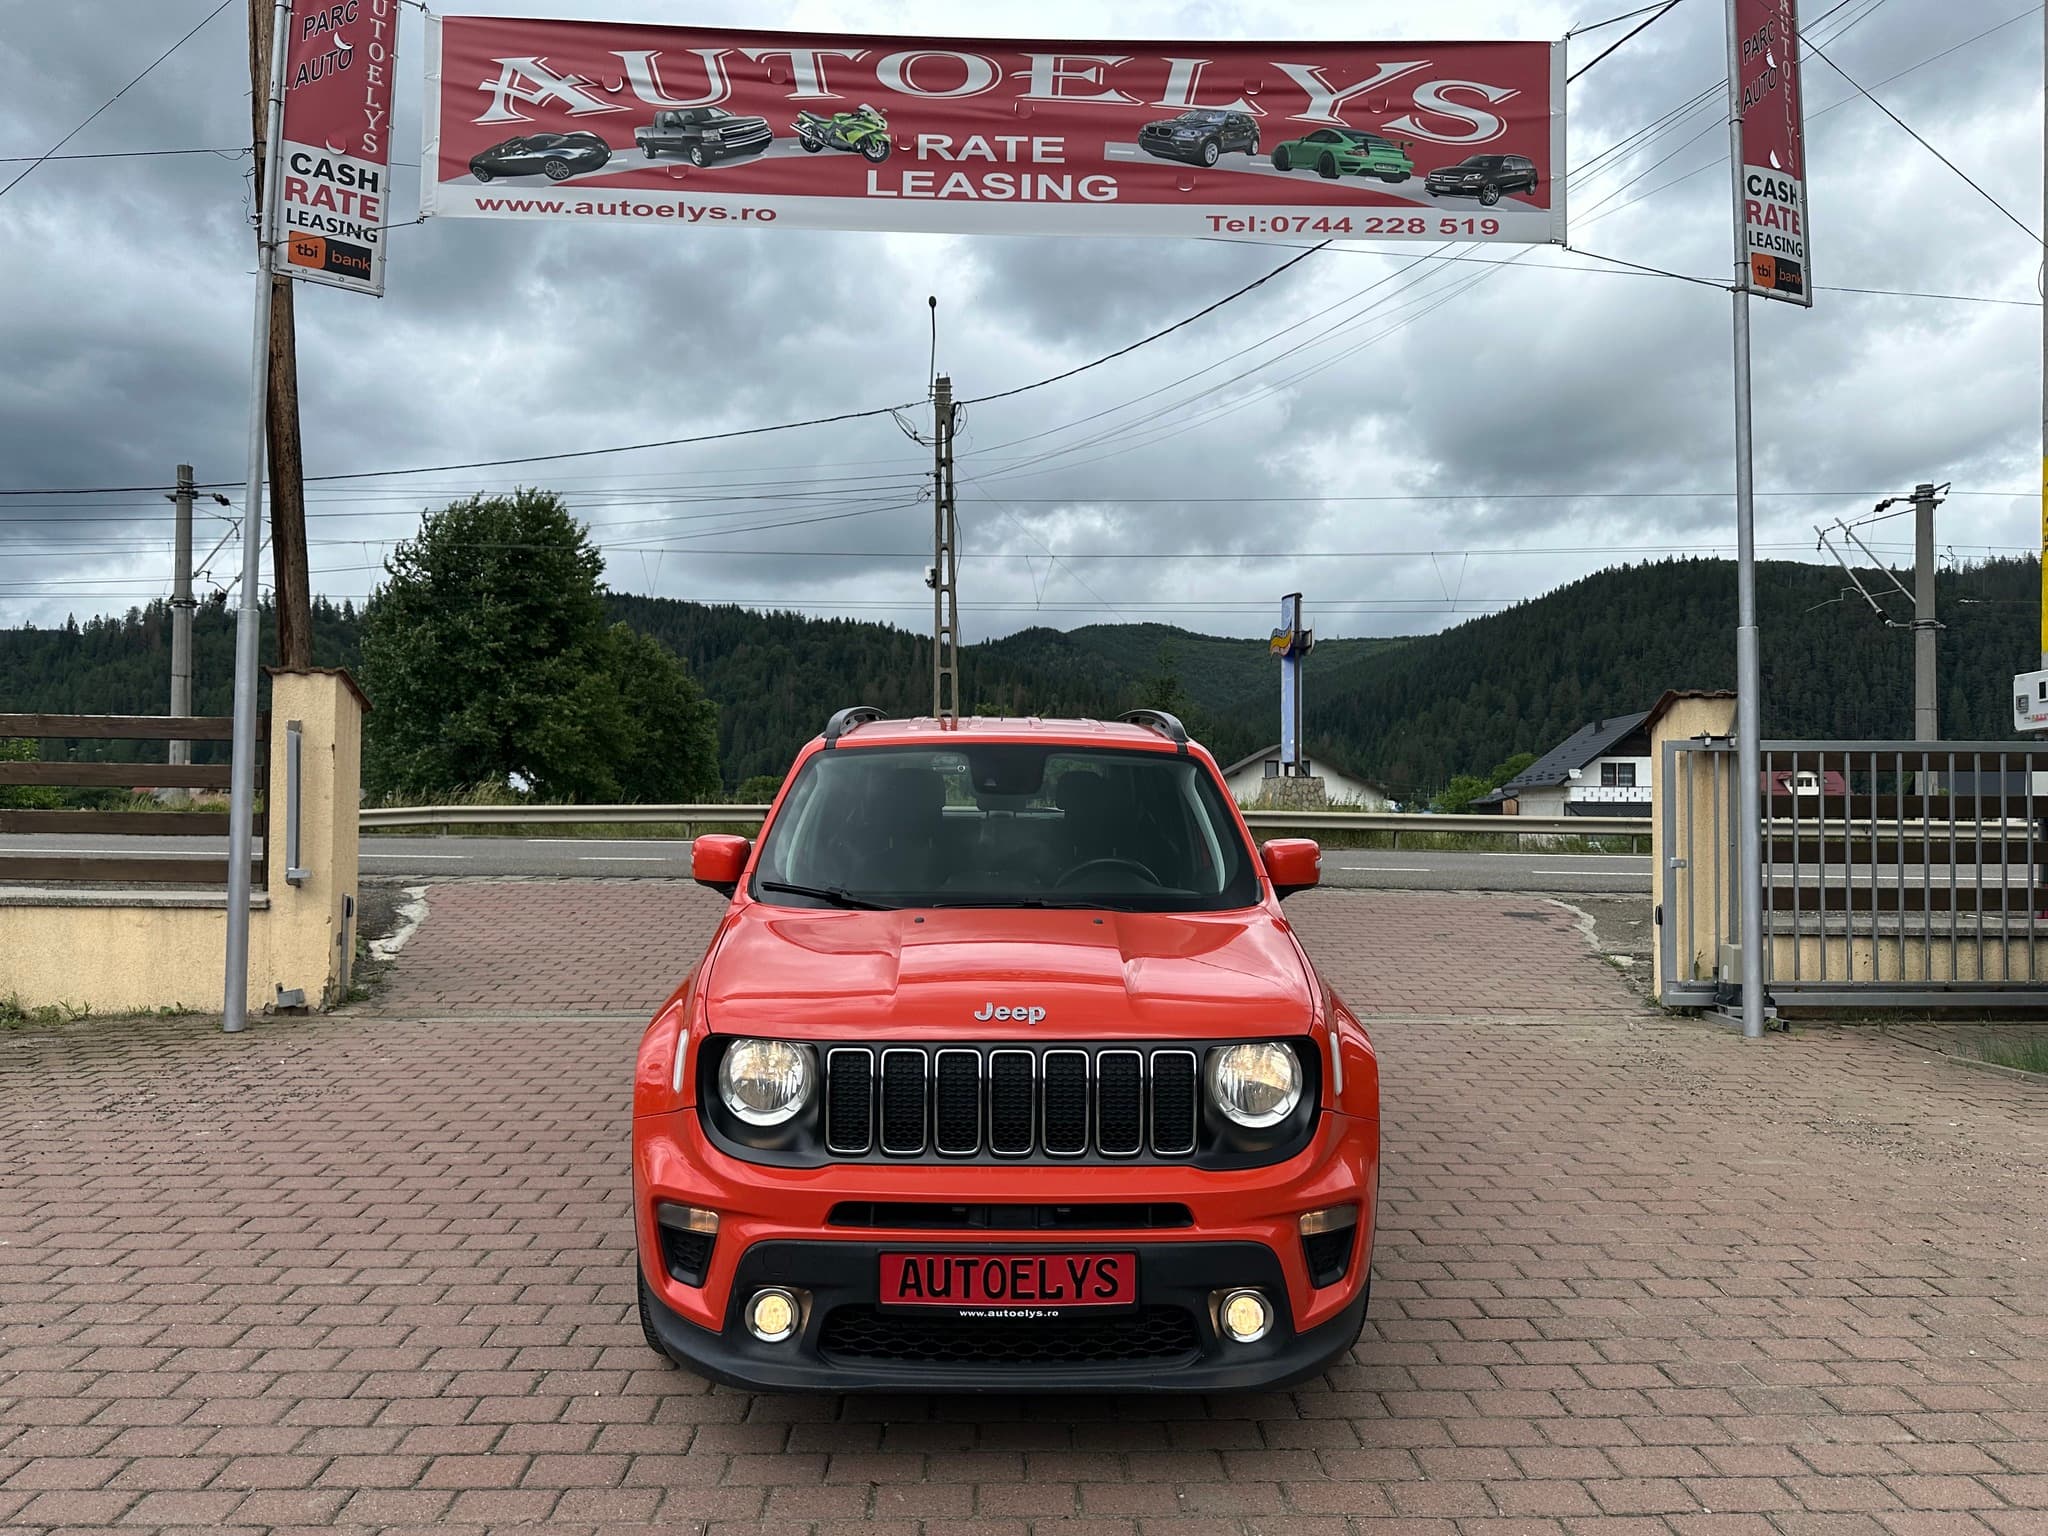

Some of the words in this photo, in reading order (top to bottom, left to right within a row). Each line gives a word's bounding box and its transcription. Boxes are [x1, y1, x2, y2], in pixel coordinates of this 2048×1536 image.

[302, 0, 359, 41] PARC
[1743, 19, 1776, 65] PARC
[293, 43, 354, 90] AUTO
[470, 47, 1522, 145] AUTOELYS
[1742, 66, 1777, 114] AUTO
[917, 133, 1066, 163] RATE
[290, 153, 379, 193] CASH
[867, 169, 1119, 201] LEASING
[284, 176, 380, 223] RATE
[1747, 174, 1798, 208] CASH
[286, 208, 378, 243] LEASING
[475, 198, 777, 222] www.autoelys.ro
[1206, 215, 1353, 233] Tel:0744
[1365, 217, 1427, 234] 228
[1439, 218, 1500, 235] 519
[1745, 199, 1801, 236] RATE
[295, 244, 318, 258] tbi
[331, 250, 371, 271] bank
[1748, 230, 1803, 258] LEASING
[1757, 264, 1771, 278] tbi
[975, 1002, 1046, 1025] Jeep
[898, 1257, 1119, 1299] AUTOELYS
[959, 1309, 1059, 1318] www.autoelys.ro
